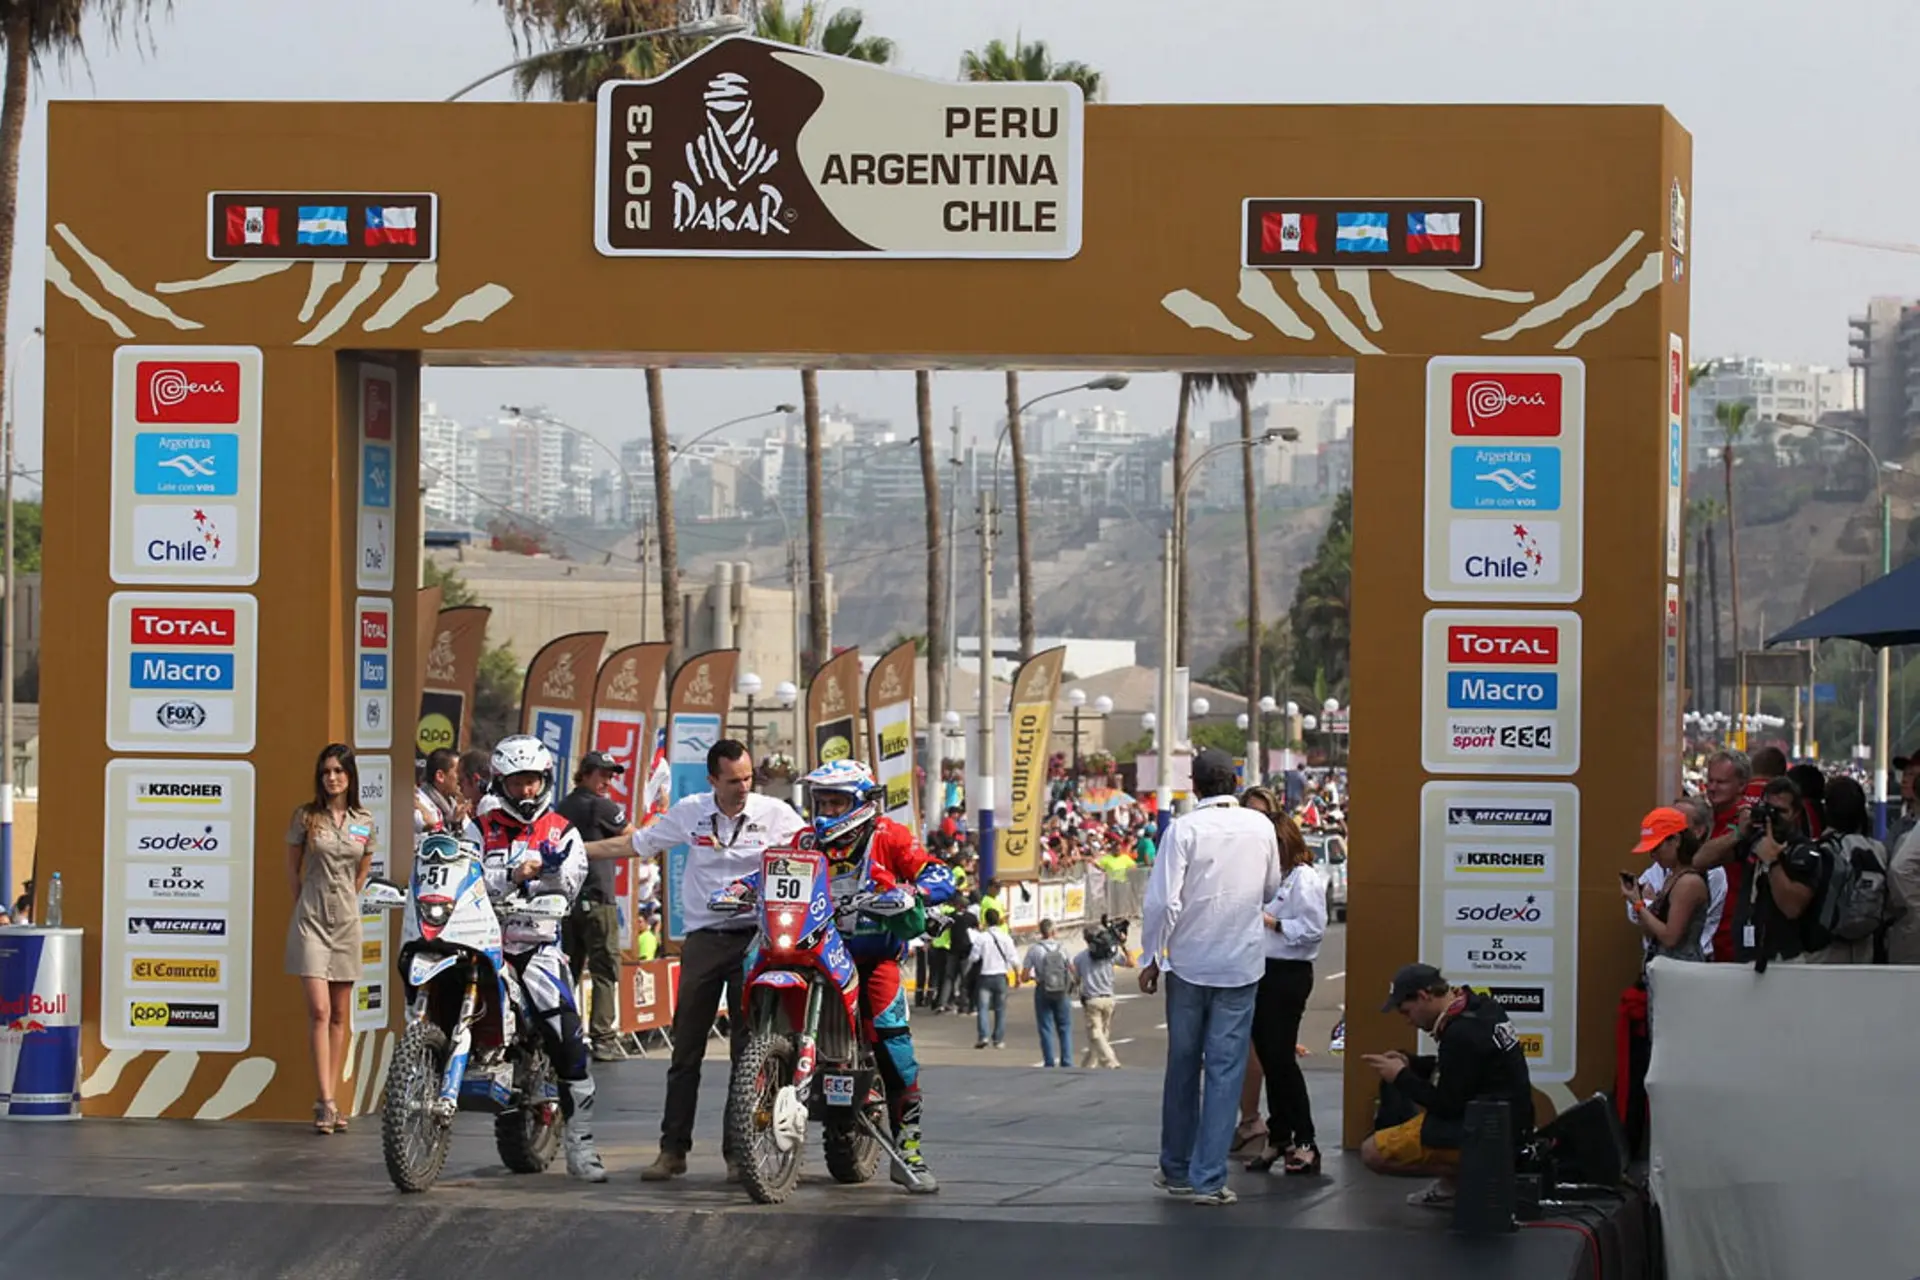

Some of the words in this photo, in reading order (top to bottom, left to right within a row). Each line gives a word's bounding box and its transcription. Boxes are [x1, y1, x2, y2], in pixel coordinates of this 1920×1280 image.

[945, 106, 1059, 139] PERU
[625, 103, 653, 231] 2013
[819, 153, 1058, 185] ARGENTINA
[671, 180, 790, 236] DAKAR
[942, 201, 1057, 232] CHILE
[150, 369, 225, 416] Perú
[1466, 380, 1546, 427] Perú
[158, 436, 211, 451] Argentina
[1475, 450, 1532, 465] Argentina
[1516, 498, 1537, 507] vos
[148, 540, 207, 561] Chile
[1465, 556, 1528, 578] Chile
[139, 615, 227, 636] TOTAL
[362, 618, 387, 639] TOTAL
[1456, 634, 1550, 654] TOTAL
[142, 659, 221, 681] Macro
[363, 660, 385, 682] Macro
[1461, 679, 1544, 701] Macro
[166, 706, 196, 721] FOX
[1452, 724, 1497, 735] francetv
[1452, 735, 1496, 750] sport
[149, 782, 222, 797] KÄRCHER
[1475, 811, 1548, 822] MICHELIN
[138, 832, 218, 851] sodexo
[1467, 852, 1544, 866] KÄRCHER
[149, 878, 204, 890] EDOX
[428, 866, 449, 886] 51
[776, 879, 800, 899] 50
[1456, 903, 1541, 922] sodexo
[152, 920, 223, 932] MICHELIN
[1467, 951, 1528, 962] EDOX
[134, 961, 153, 977] El
[154, 961, 217, 978] Comercio
[0, 994, 25, 1014] ed
[29, 994, 67, 1014] Bull
[170, 1009, 216, 1021] NOTICIAS
